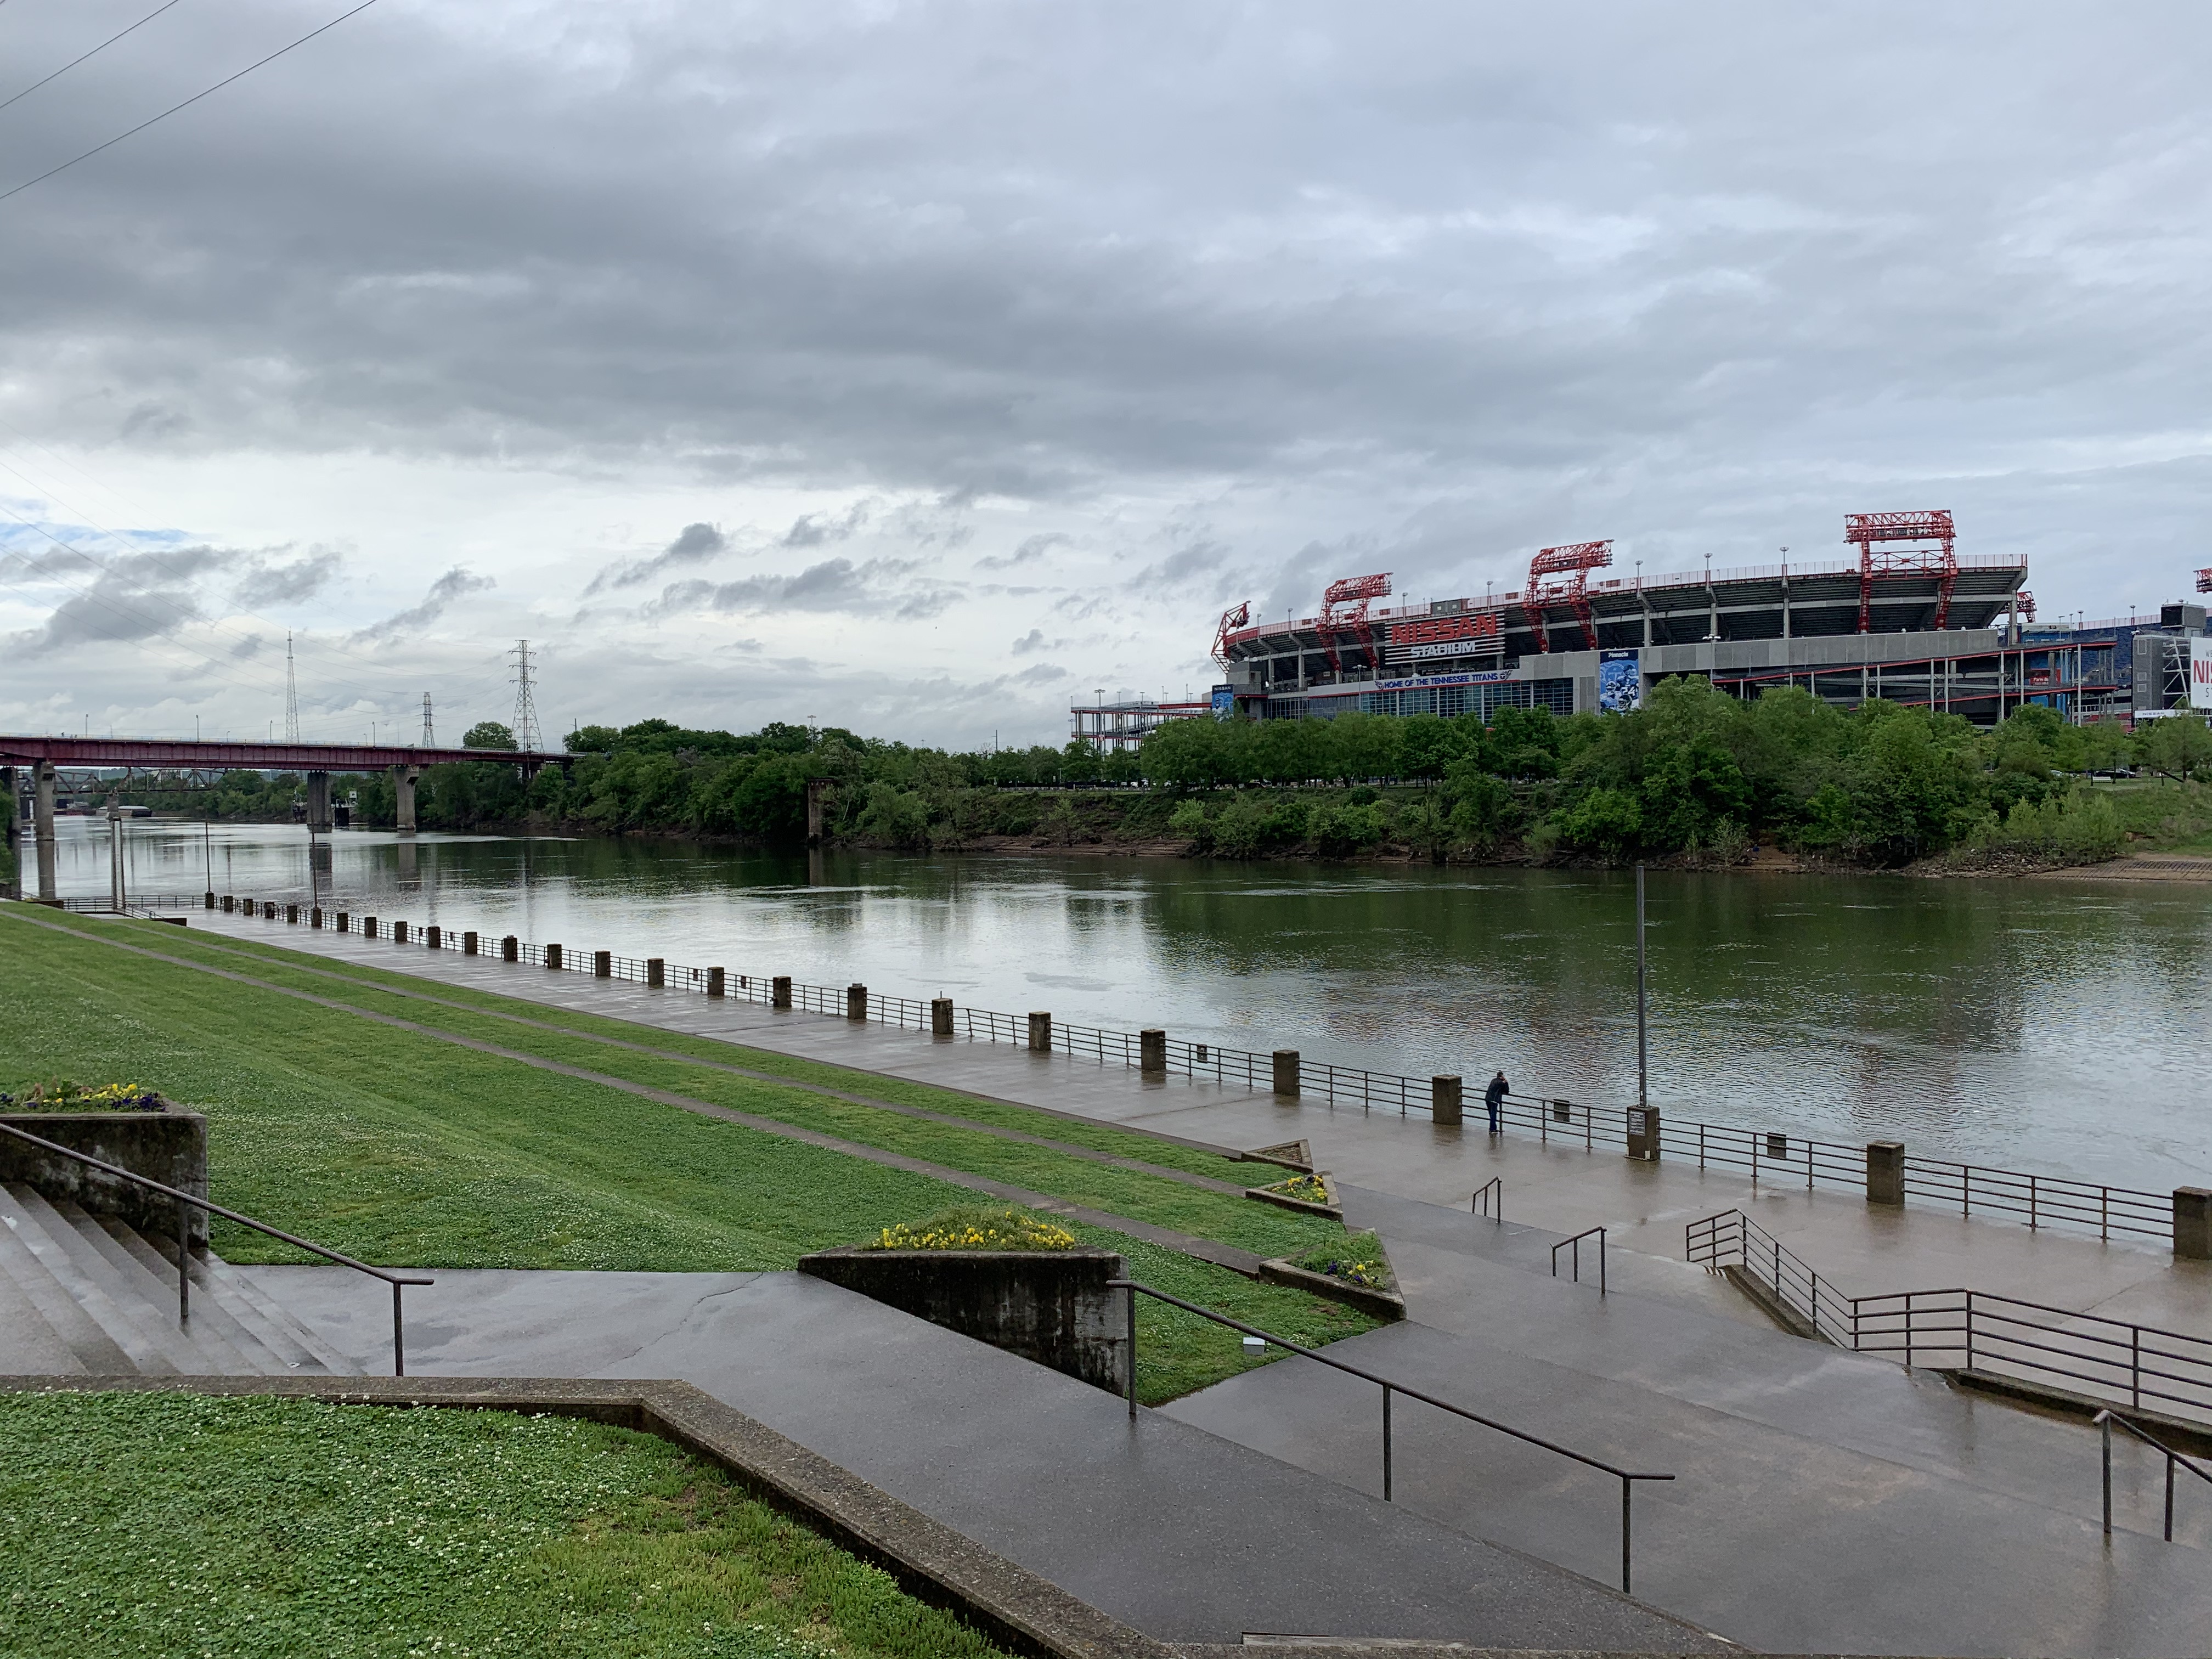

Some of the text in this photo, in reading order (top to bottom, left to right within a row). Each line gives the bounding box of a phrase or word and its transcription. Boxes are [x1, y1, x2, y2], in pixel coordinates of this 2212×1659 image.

[1391, 613, 1496, 645] NISSAN
[1410, 641, 1476, 658] STADIUM
[1430, 675, 1469, 685] TENNESSEE
[1471, 673, 1498, 681] TITANS
